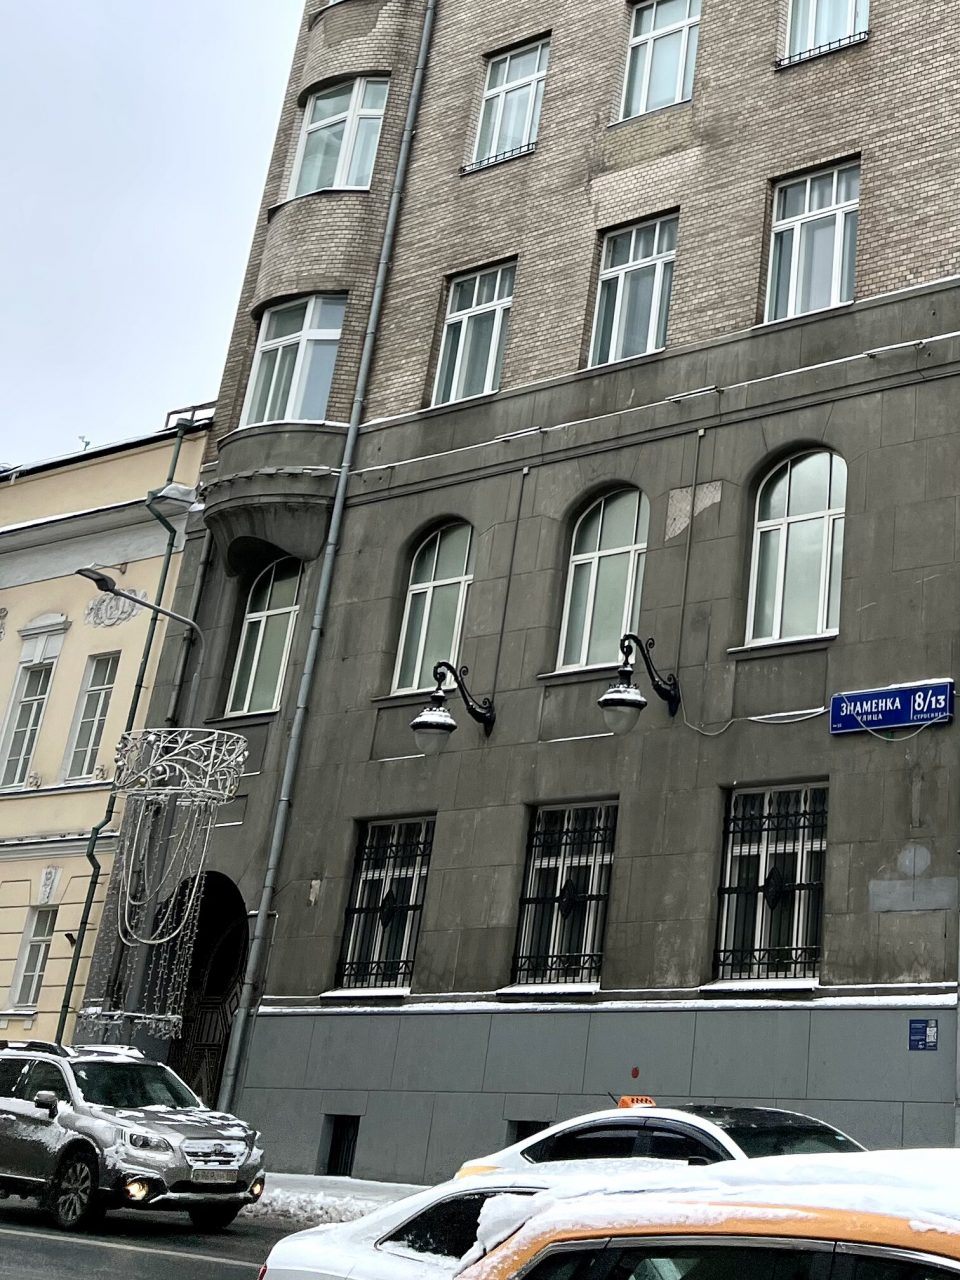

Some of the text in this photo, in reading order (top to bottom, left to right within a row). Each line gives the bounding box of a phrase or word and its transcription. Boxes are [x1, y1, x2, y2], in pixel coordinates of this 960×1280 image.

[840, 697, 901, 715] ЗНАМЕНКА
[914, 690, 945, 712] 8/13
[857, 713, 883, 721] УЛИЦА
